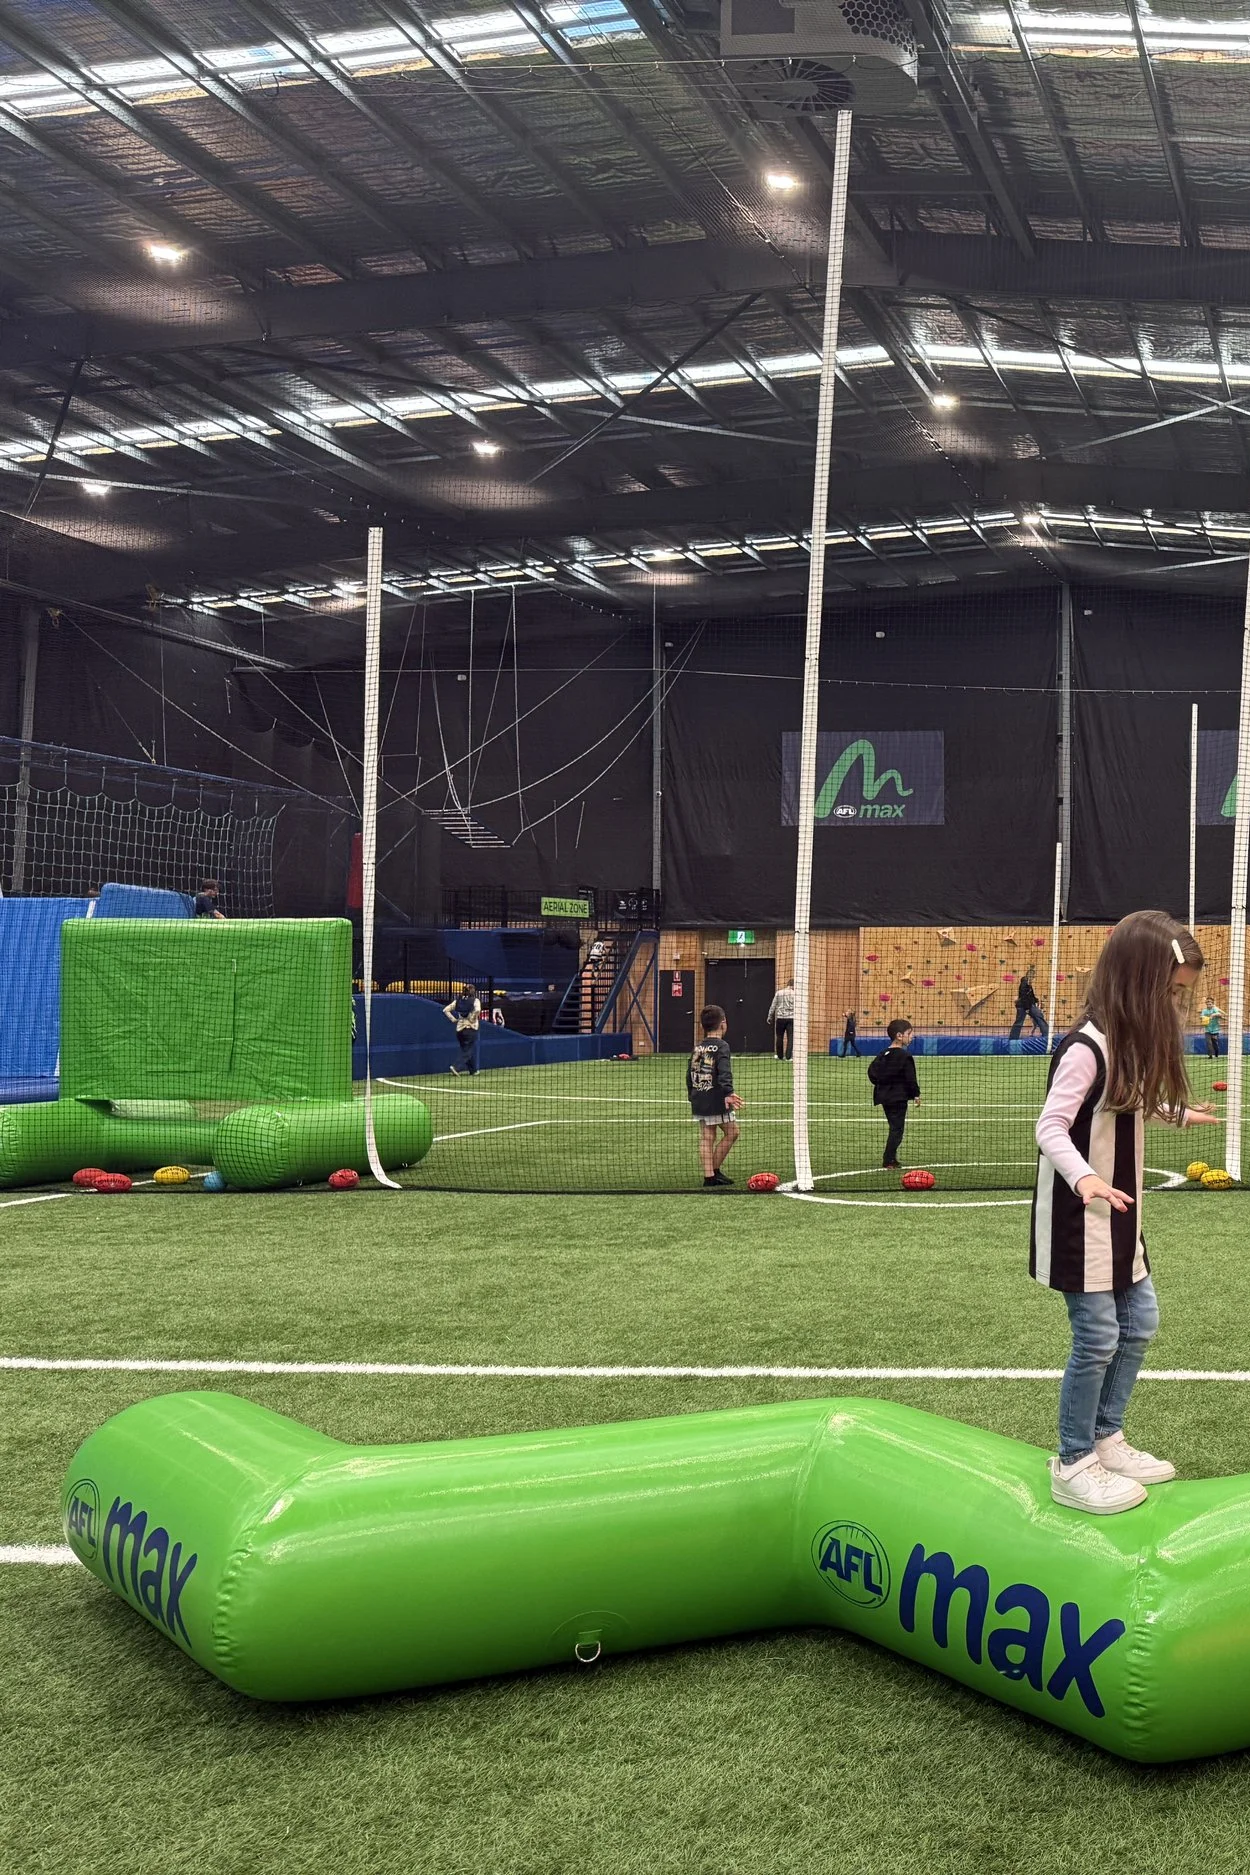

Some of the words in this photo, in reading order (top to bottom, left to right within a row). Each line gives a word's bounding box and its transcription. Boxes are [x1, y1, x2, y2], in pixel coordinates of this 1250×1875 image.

[859, 804, 906, 818] max
[543, 900, 567, 914] AERIAL
[569, 902, 588, 914] ZONE
[68, 1495, 96, 1549] AFL
[103, 1496, 198, 1649] max
[819, 1536, 883, 1596] AFL
[898, 1543, 1126, 1718] max
